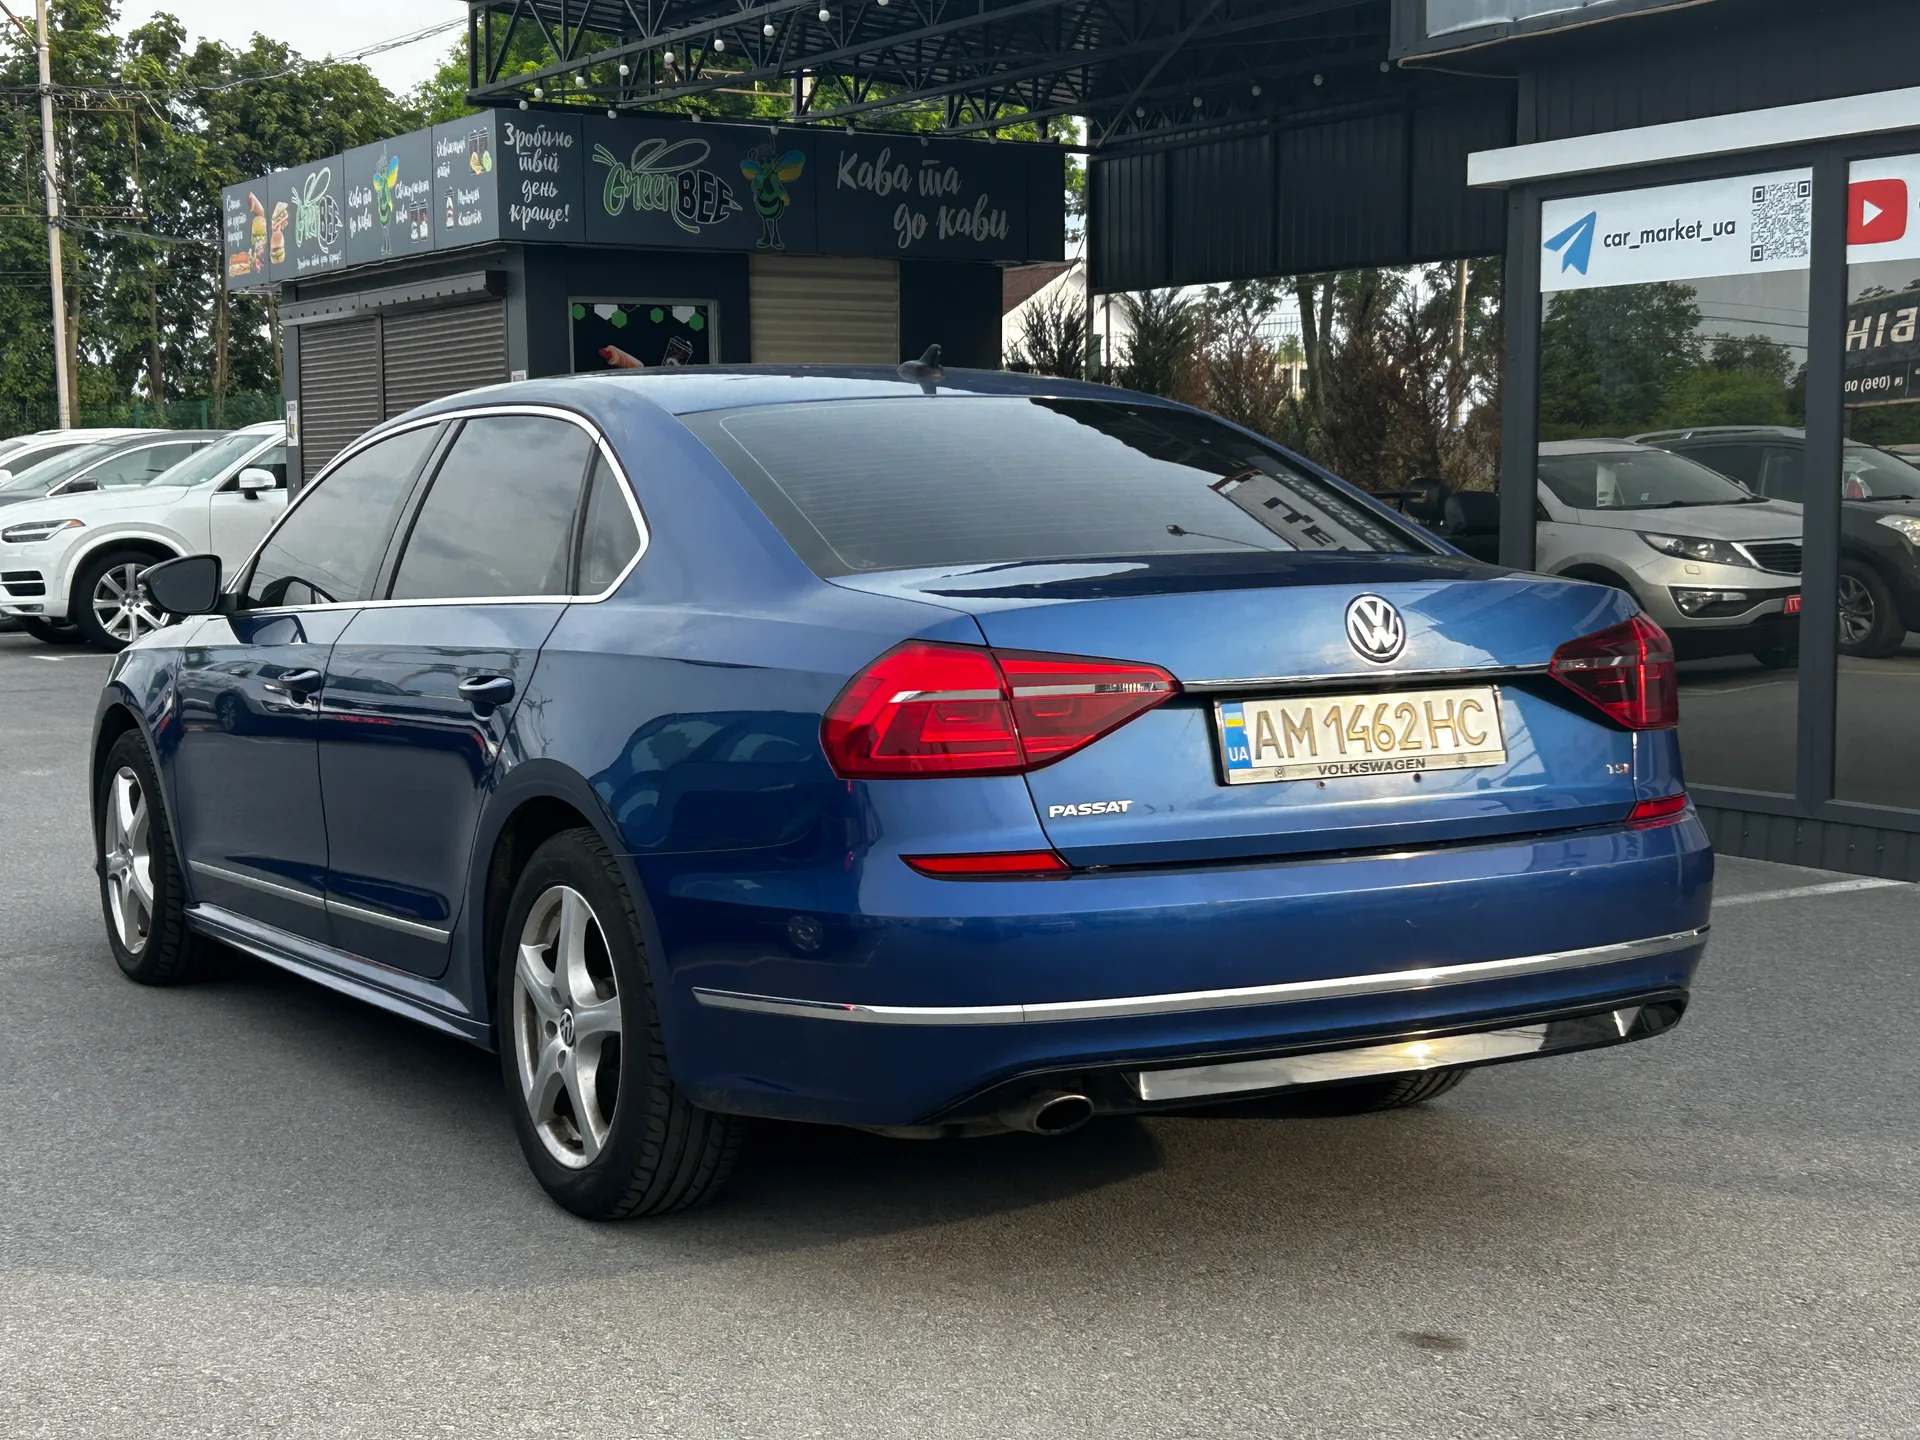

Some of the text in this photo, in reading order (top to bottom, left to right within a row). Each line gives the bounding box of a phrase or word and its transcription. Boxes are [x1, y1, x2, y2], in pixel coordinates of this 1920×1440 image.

[504, 122, 574, 155] Зробимо
[518, 148, 560, 173] твій
[837, 147, 962, 197] Кава та
[521, 179, 558, 204] день
[509, 203, 570, 231] краще!
[893, 193, 1010, 249] до кави
[1603, 217, 1737, 250] car_market_ua
[1228, 746, 1248, 762] UA
[1317, 757, 1427, 776] VOLKSWAGEN
[1048, 799, 1134, 819] PASSAT
